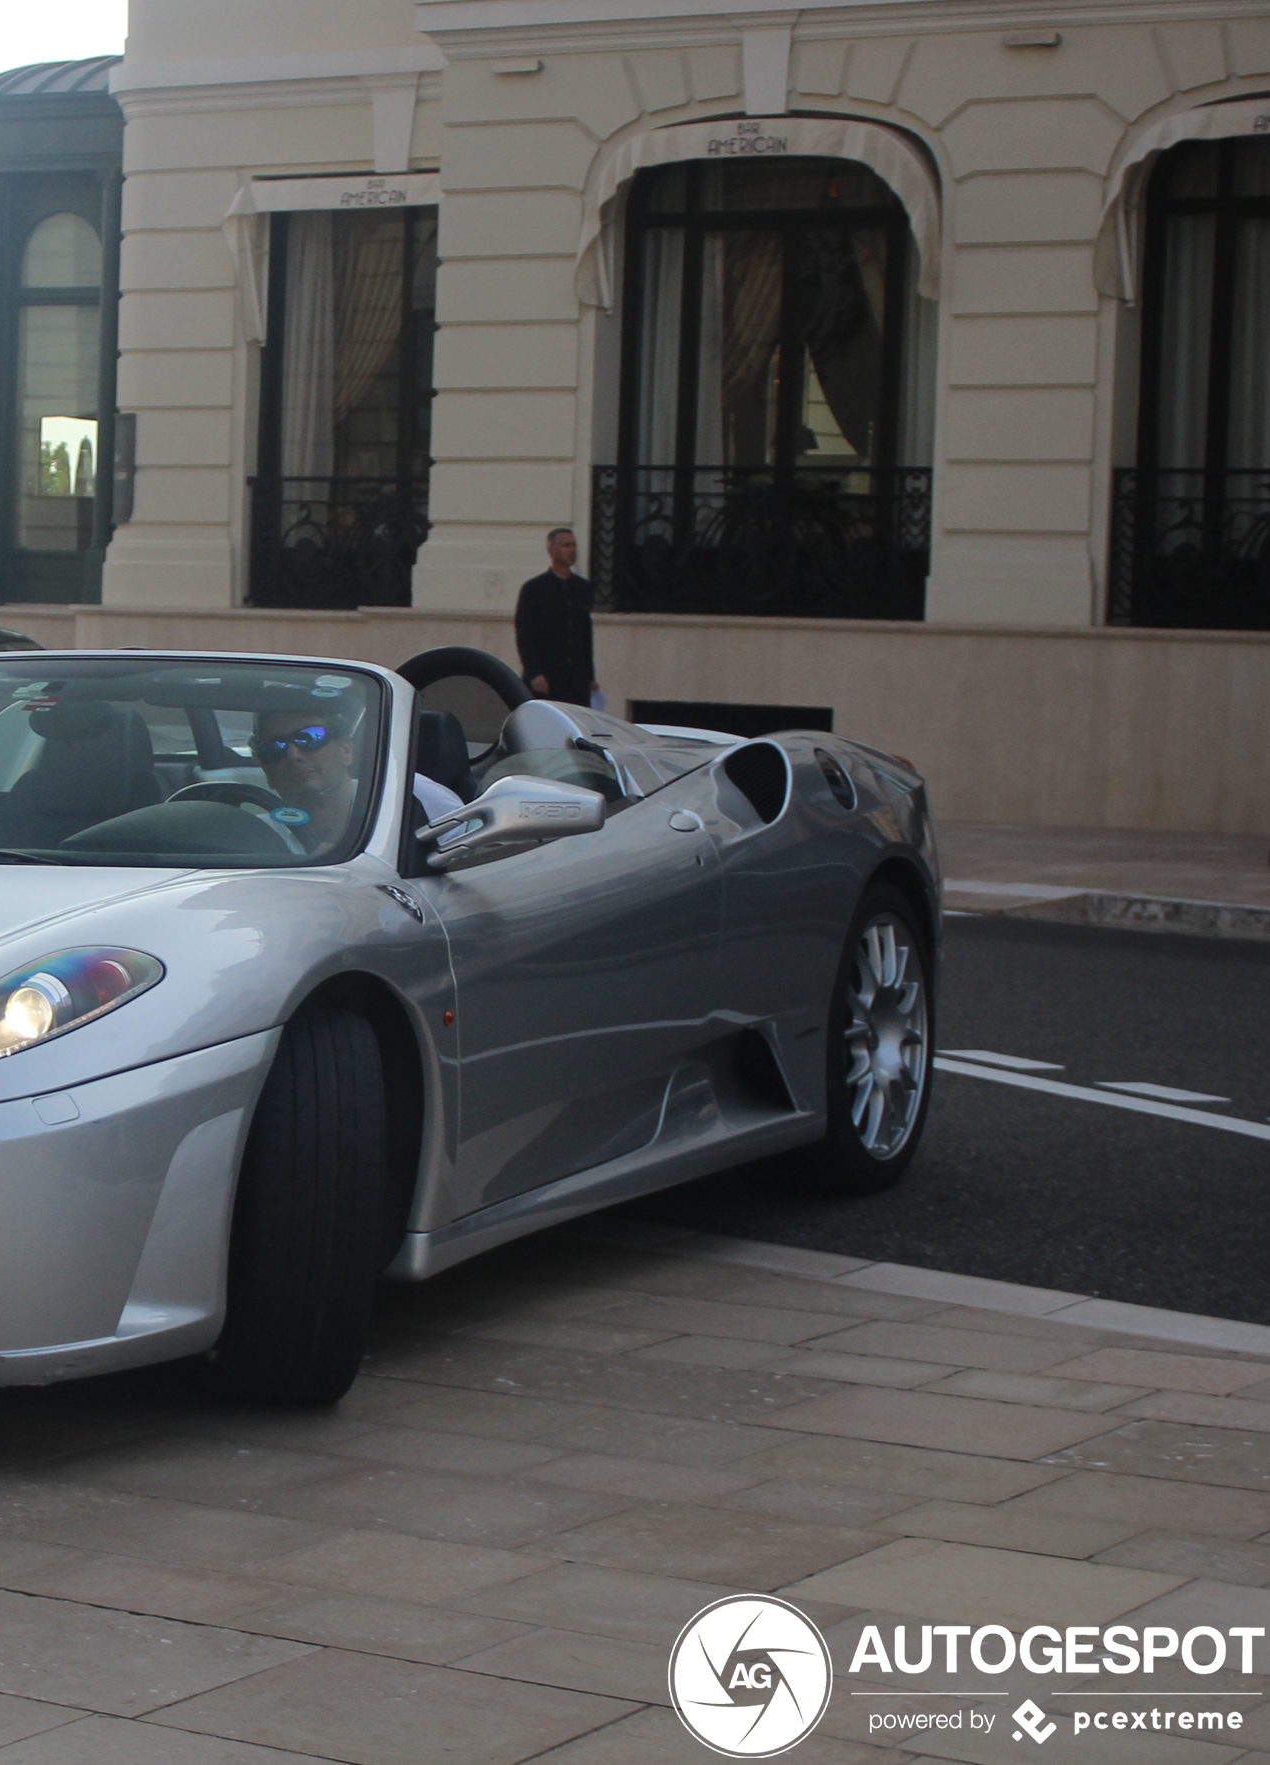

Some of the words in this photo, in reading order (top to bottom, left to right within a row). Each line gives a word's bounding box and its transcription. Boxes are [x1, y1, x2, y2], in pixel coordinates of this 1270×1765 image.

[737, 122, 760, 134] BAR
[707, 136, 788, 155] AMERICAN
[340, 190, 407, 206] AMERICAN
